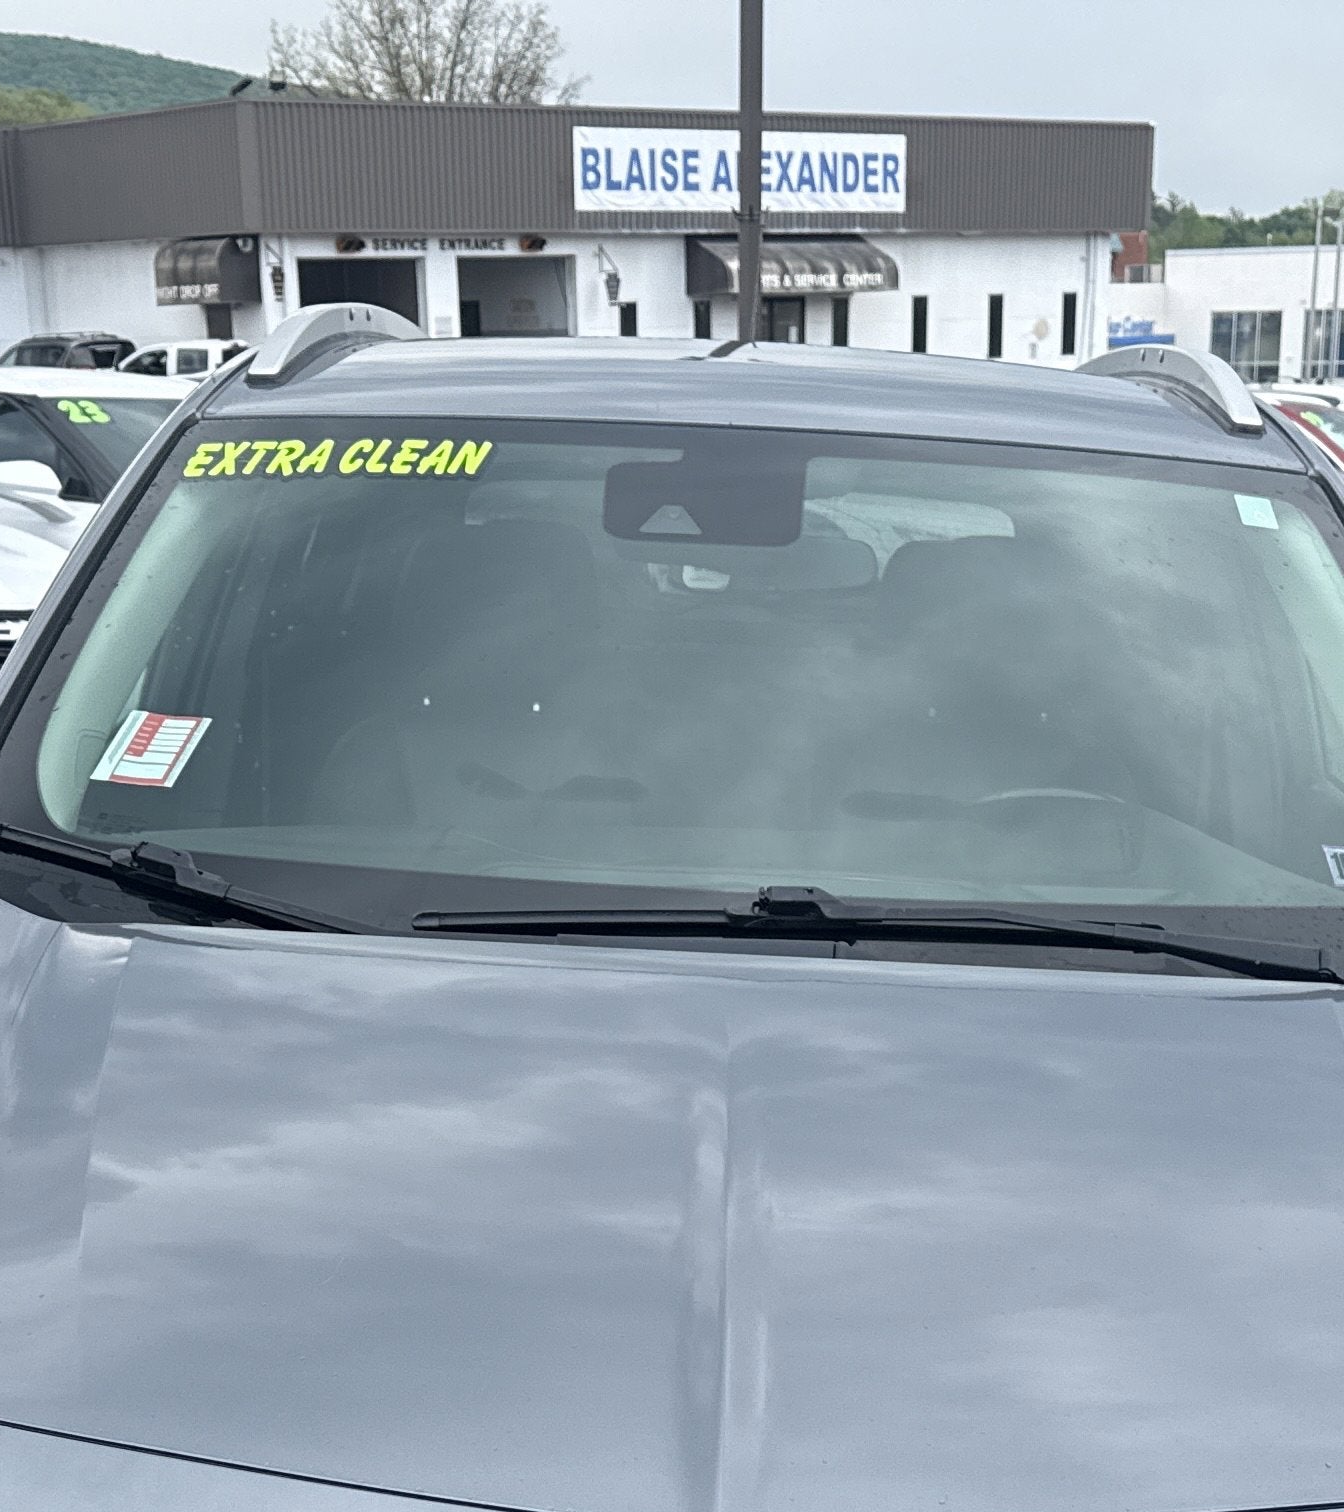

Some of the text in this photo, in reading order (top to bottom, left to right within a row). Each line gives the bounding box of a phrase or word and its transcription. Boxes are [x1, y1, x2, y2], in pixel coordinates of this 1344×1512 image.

[580, 147, 900, 193] BLAISE AEXANDER
[371, 238, 506, 251] SERVICE ENTRANCE
[57, 399, 112, 424] 23
[182, 437, 494, 478] EXTRA CLEAN
